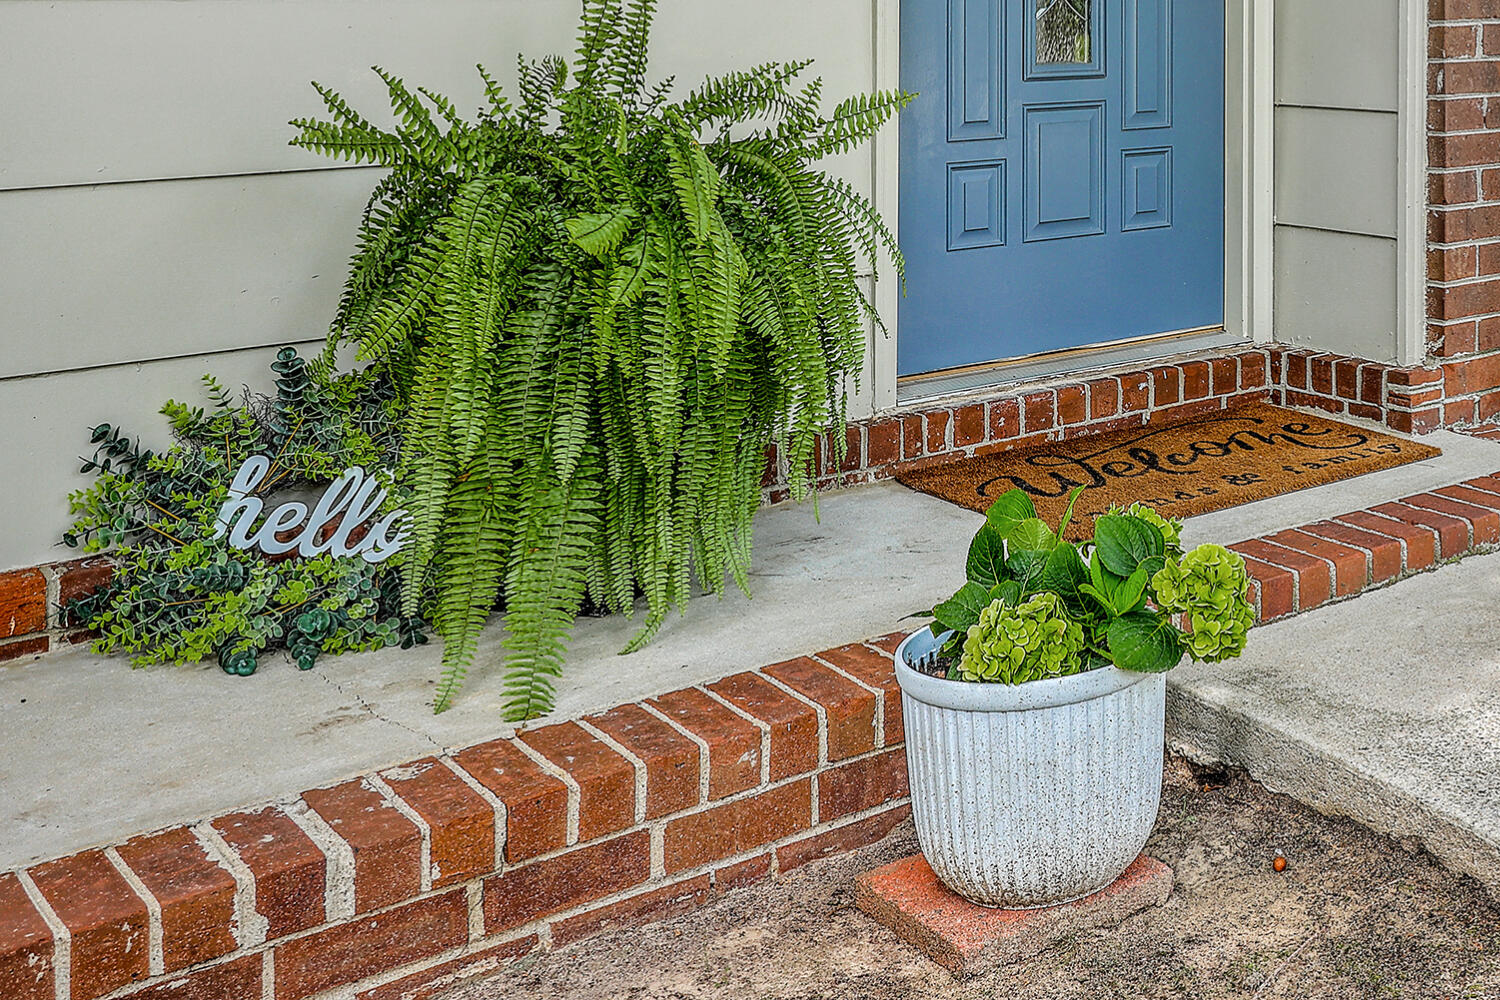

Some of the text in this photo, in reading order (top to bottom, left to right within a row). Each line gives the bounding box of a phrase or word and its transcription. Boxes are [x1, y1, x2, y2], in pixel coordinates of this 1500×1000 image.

[975, 416, 1369, 498] Welcome
[1220, 442, 1402, 487] & family
[212, 454, 415, 563] hello
